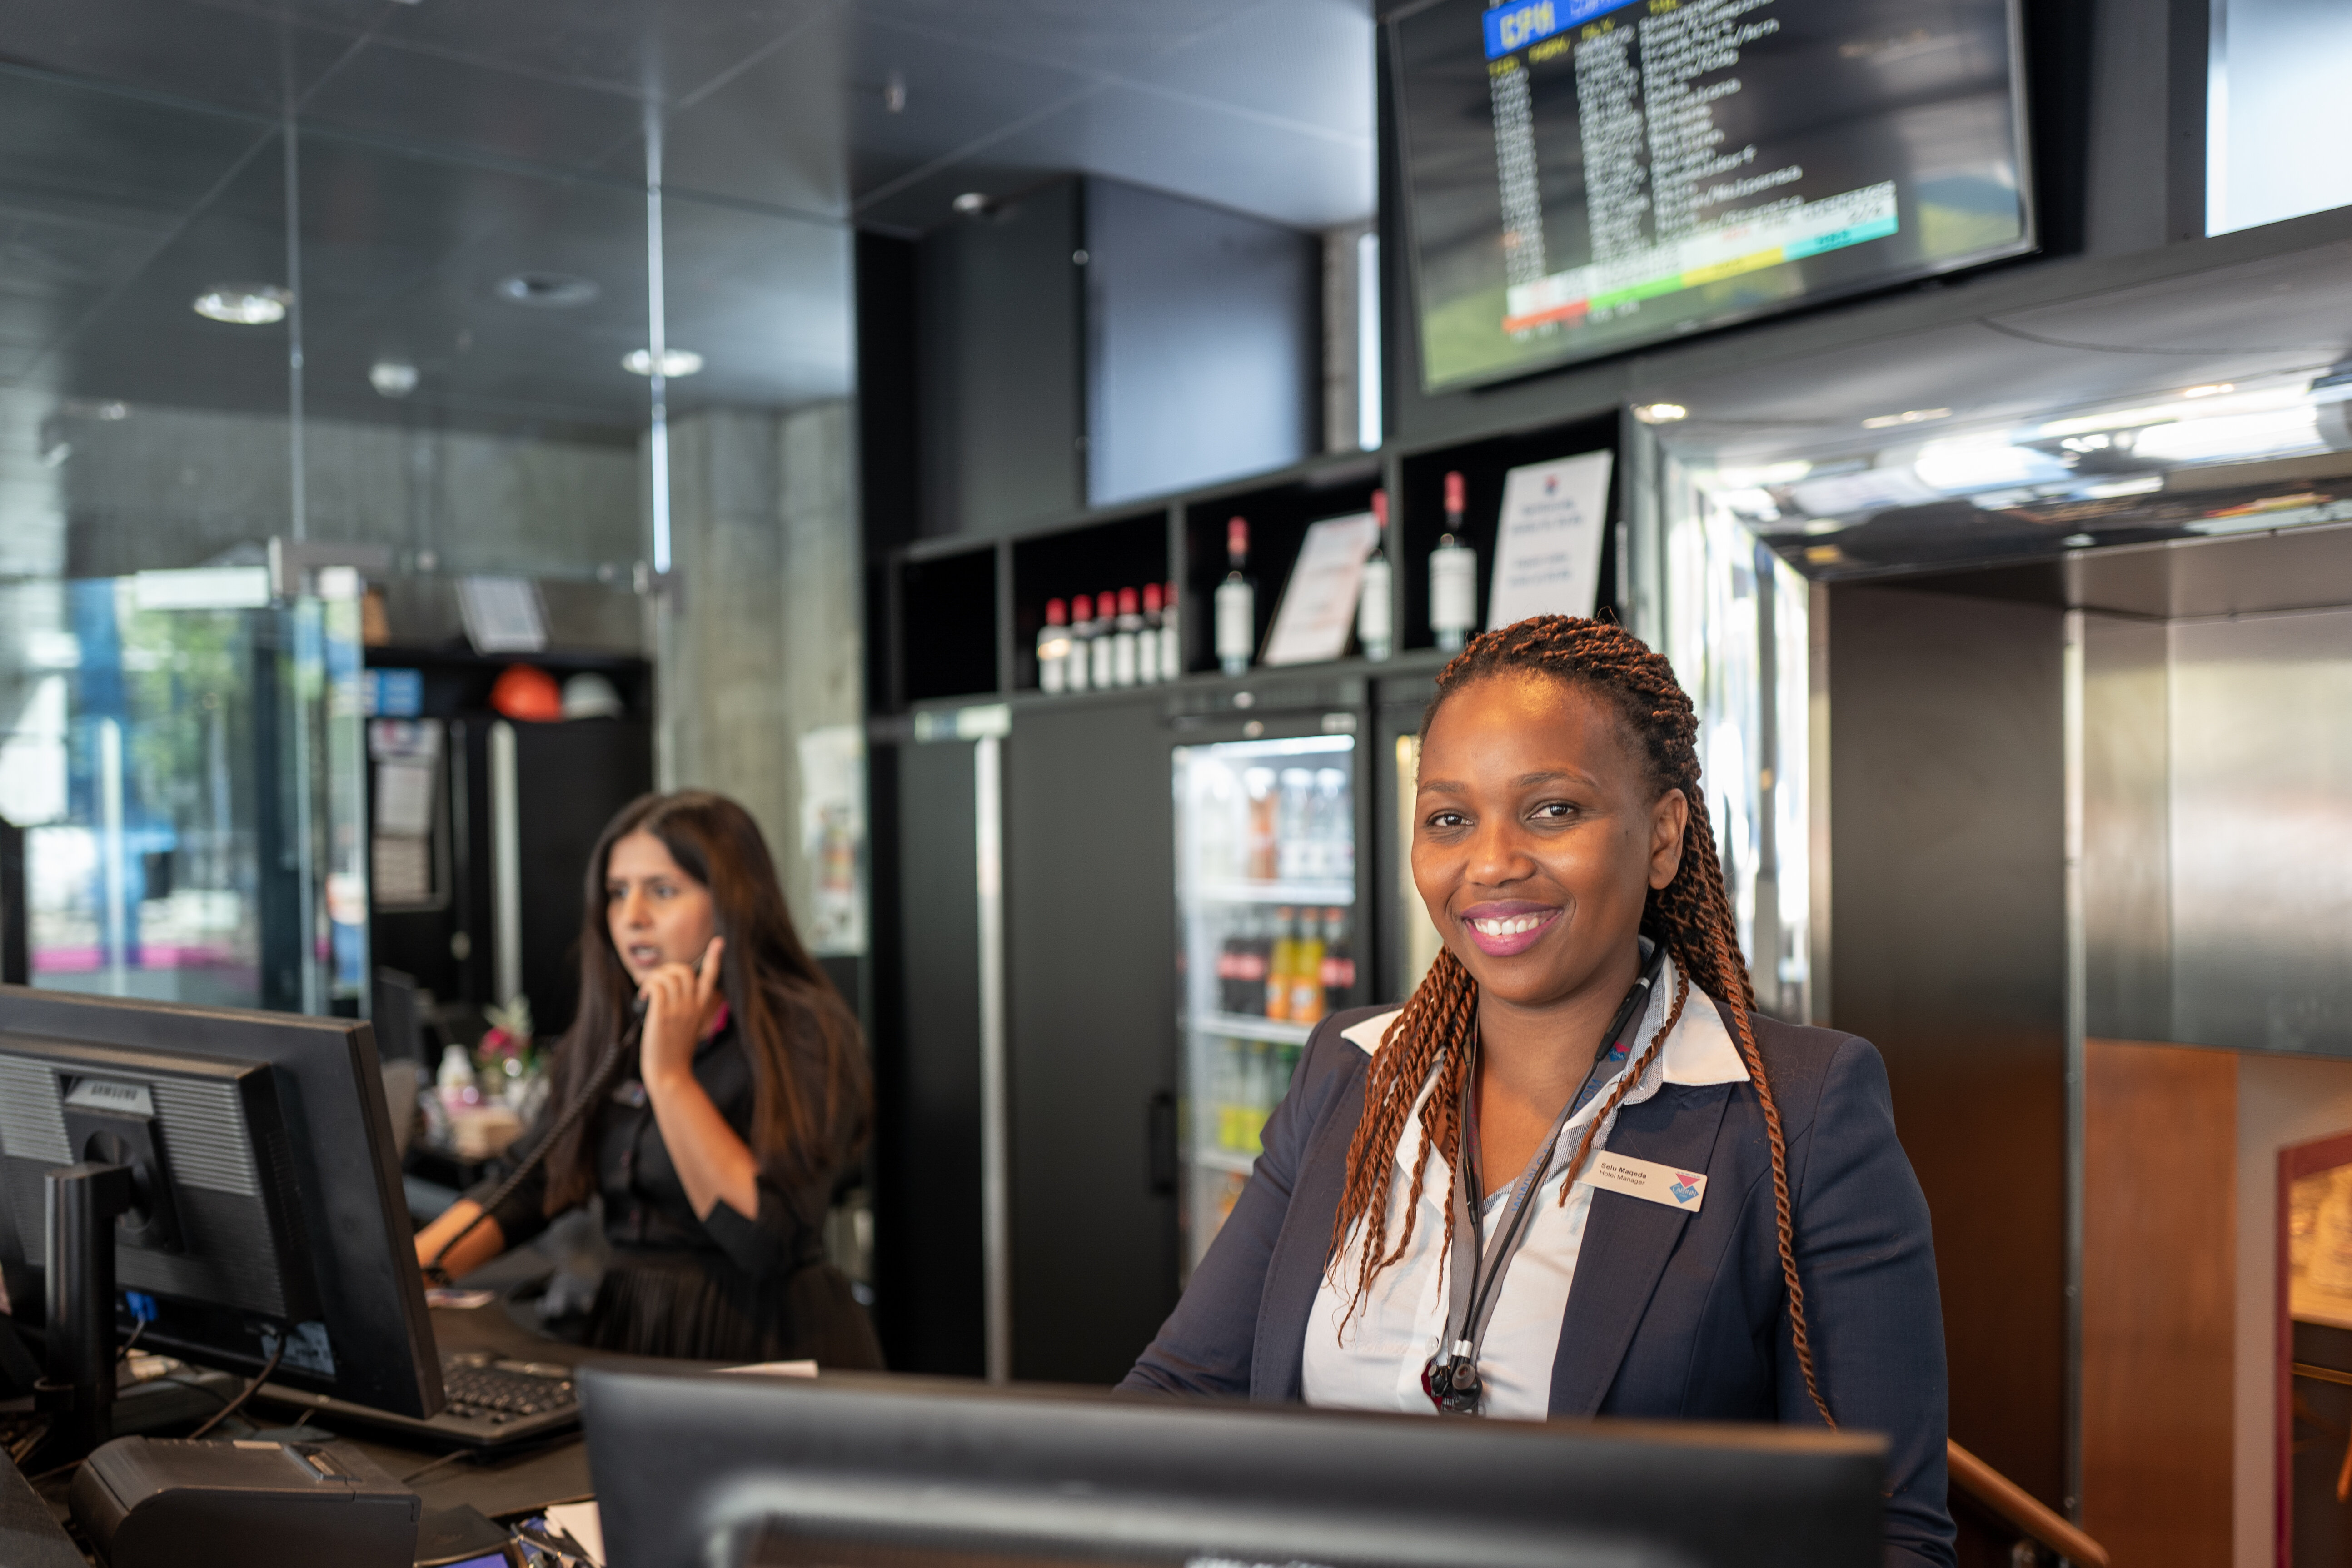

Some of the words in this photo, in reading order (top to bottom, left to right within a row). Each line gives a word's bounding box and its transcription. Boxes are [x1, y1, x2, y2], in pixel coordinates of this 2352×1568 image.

[1600, 1170, 1616, 1178] Hotel
[1617, 1174, 1645, 1185] Manager
[1601, 1162, 1617, 1171] Selu
[1619, 1166, 1647, 1179] Maqeda
